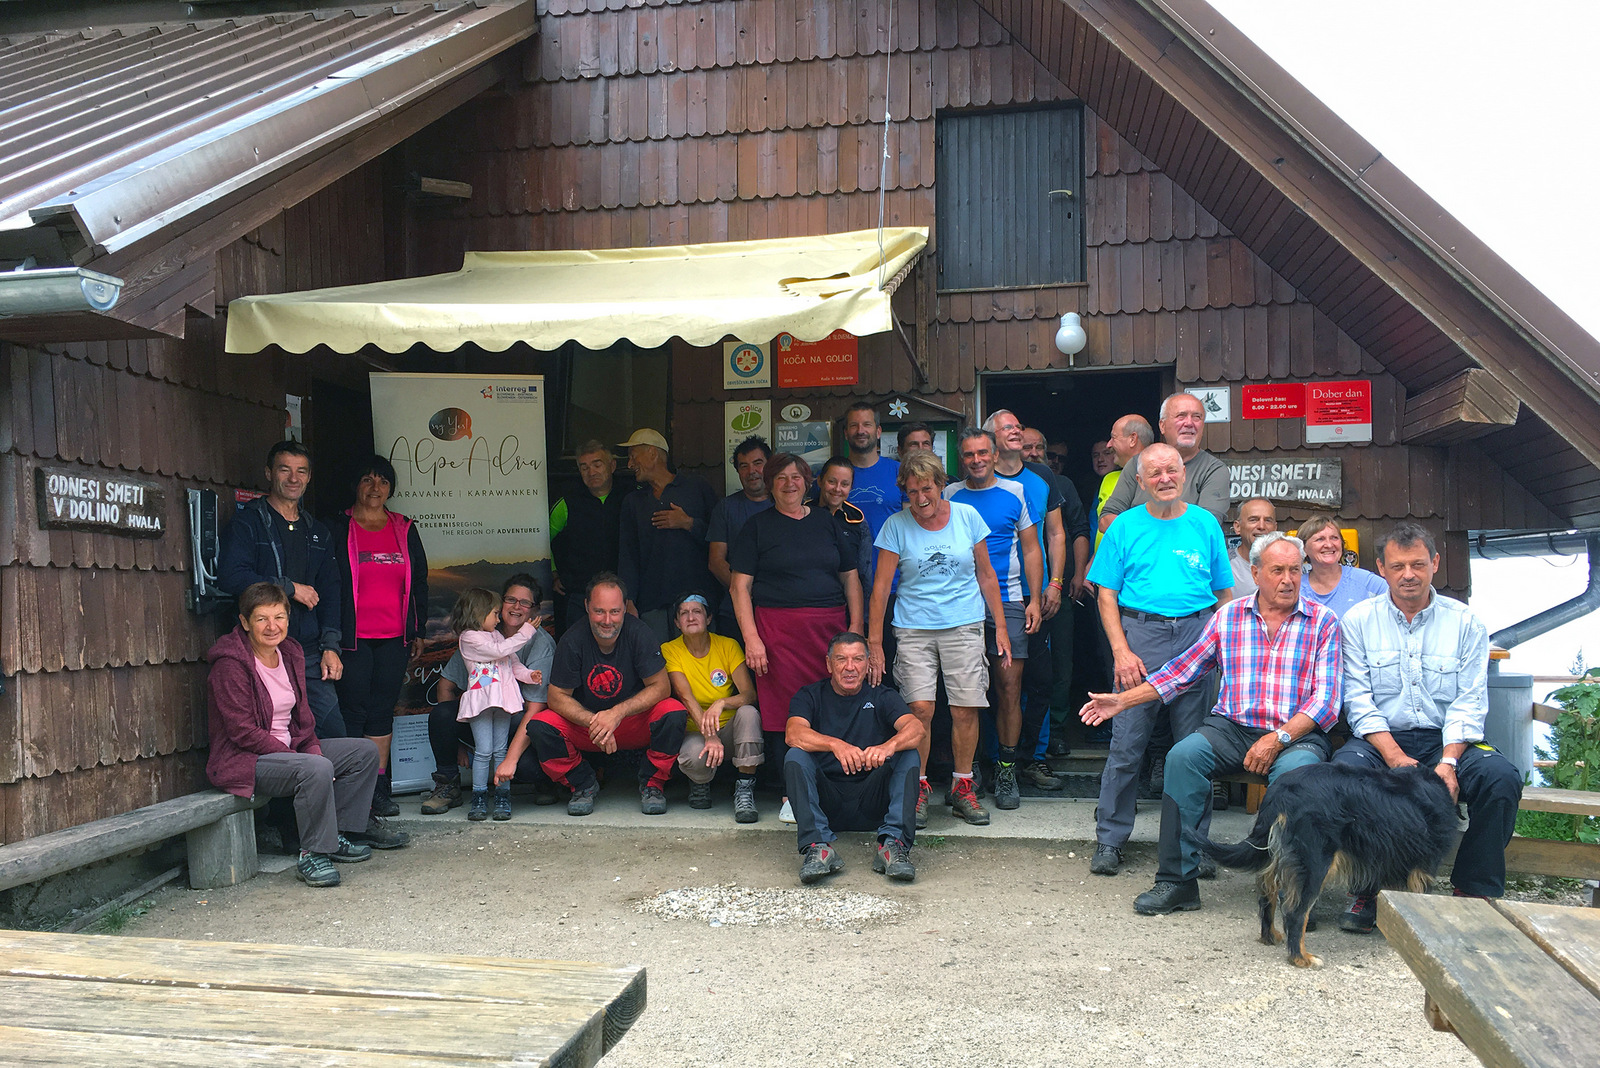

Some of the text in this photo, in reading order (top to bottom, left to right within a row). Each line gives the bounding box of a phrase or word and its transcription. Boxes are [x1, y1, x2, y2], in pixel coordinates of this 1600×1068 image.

[783, 354, 853, 365] KOČA NA GOLICI
[496, 385, 527, 393] Interreg
[1312, 388, 1365, 399] Dober dan.
[739, 404, 763, 413] Golica
[778, 430, 799, 441] NAJ
[388, 435, 543, 486] Alpe Adria
[1227, 463, 1322, 481] NESI SMETI
[48, 474, 144, 506] ODNESI SMETI
[467, 489, 539, 497] KARAWANKEN
[1229, 481, 1335, 499] DOLINO HVALA
[53, 496, 161, 530] V DOLINO HVALA
[497, 527, 540, 535] ADVENTURES
